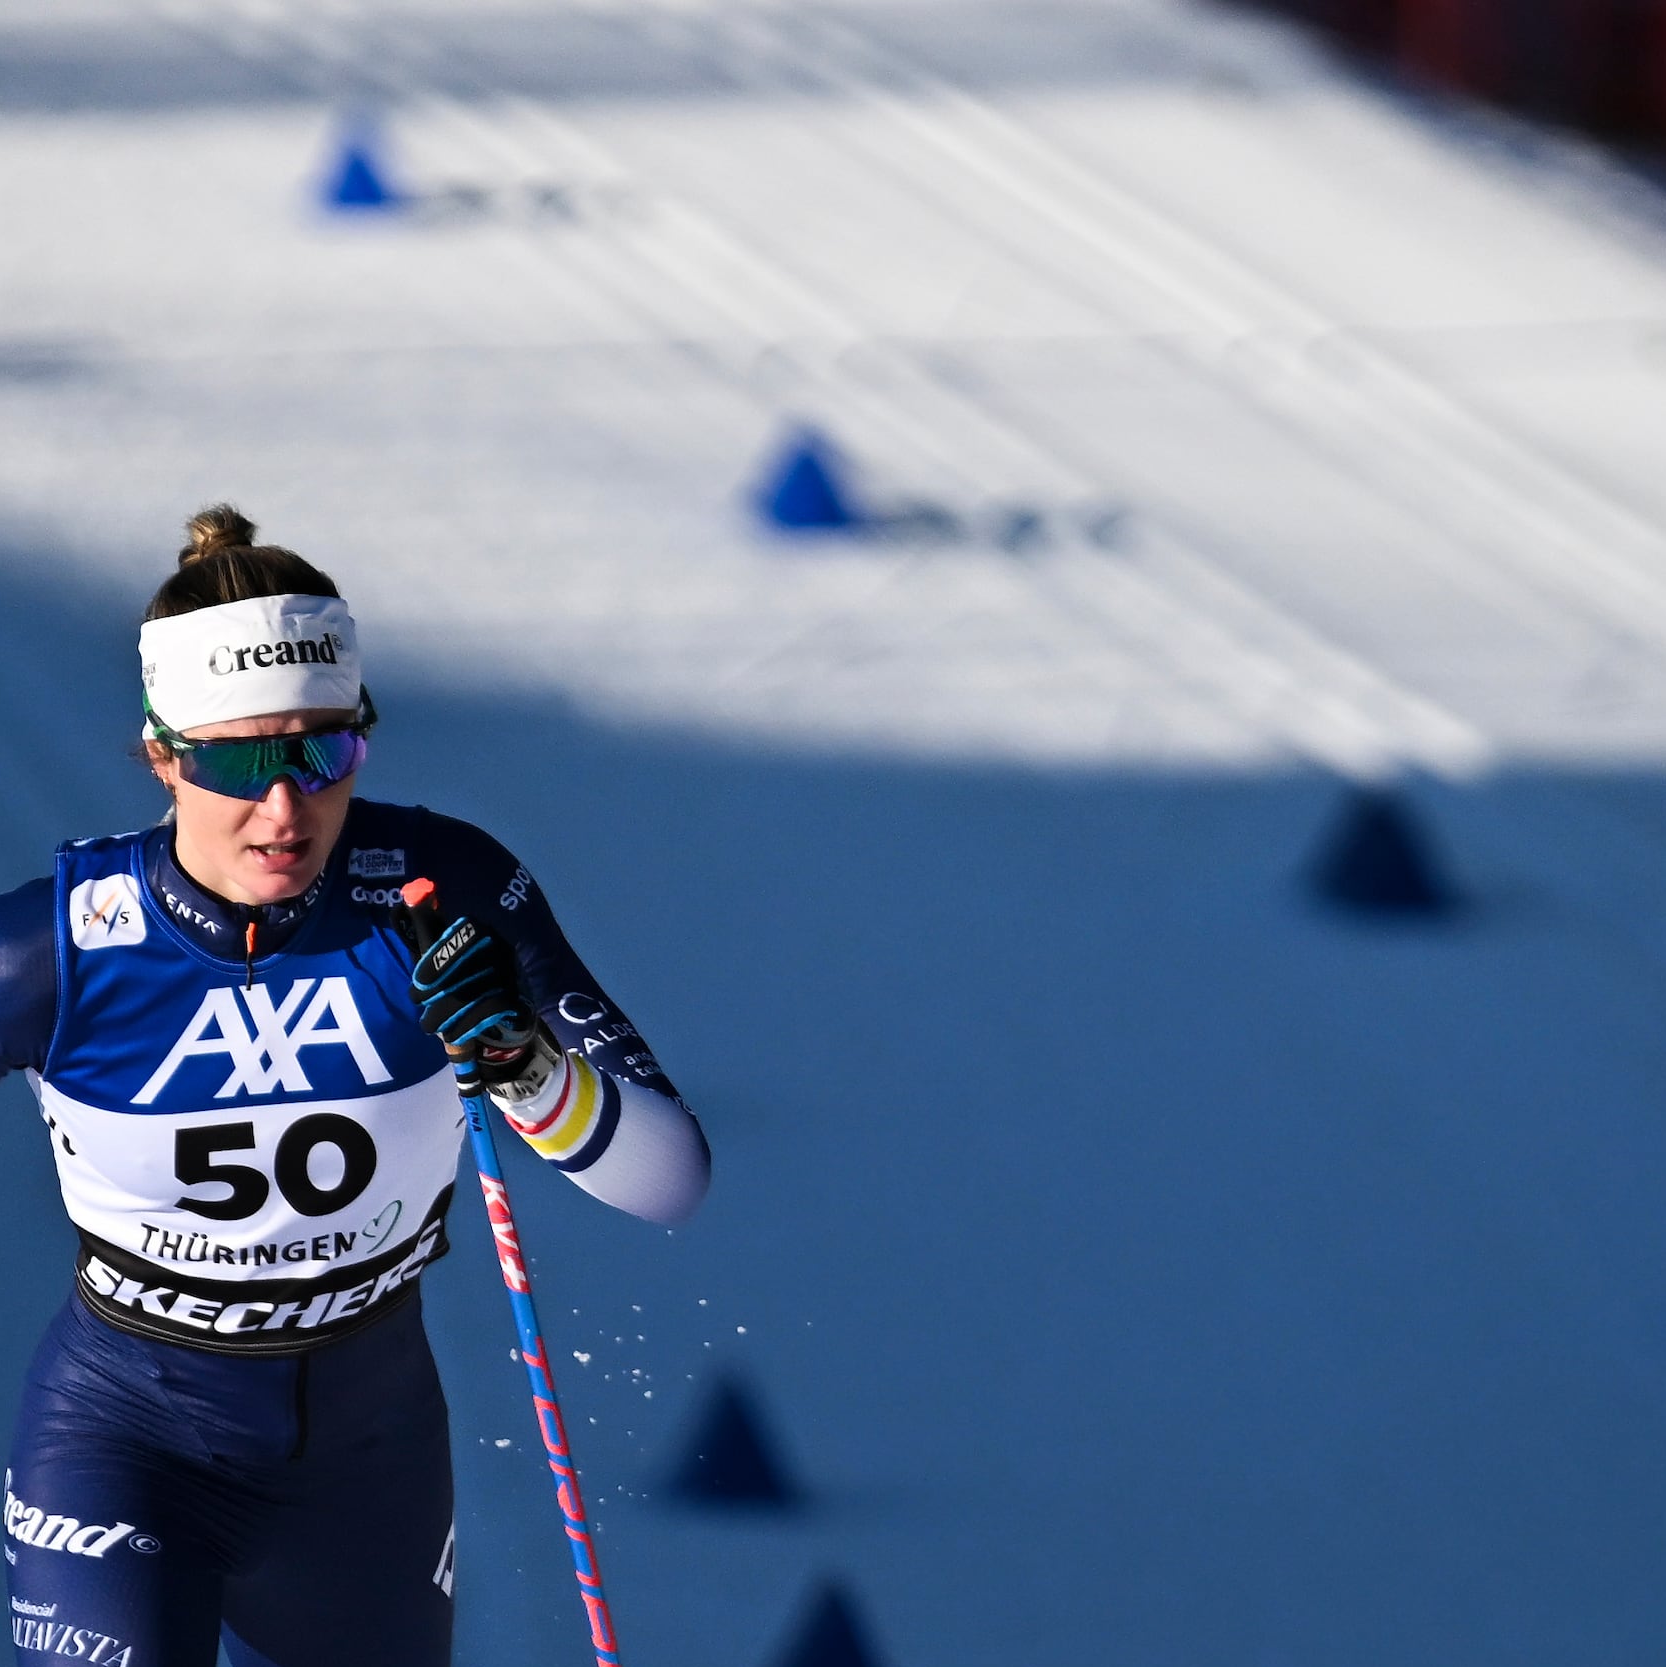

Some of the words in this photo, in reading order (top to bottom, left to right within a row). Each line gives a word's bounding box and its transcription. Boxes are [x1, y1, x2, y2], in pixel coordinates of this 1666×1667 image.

[499, 864, 532, 911] spo
[130, 976, 393, 1103] AXA
[174, 1112, 376, 1220] 50
[141, 1222, 356, 1266] THÜRINGEN
